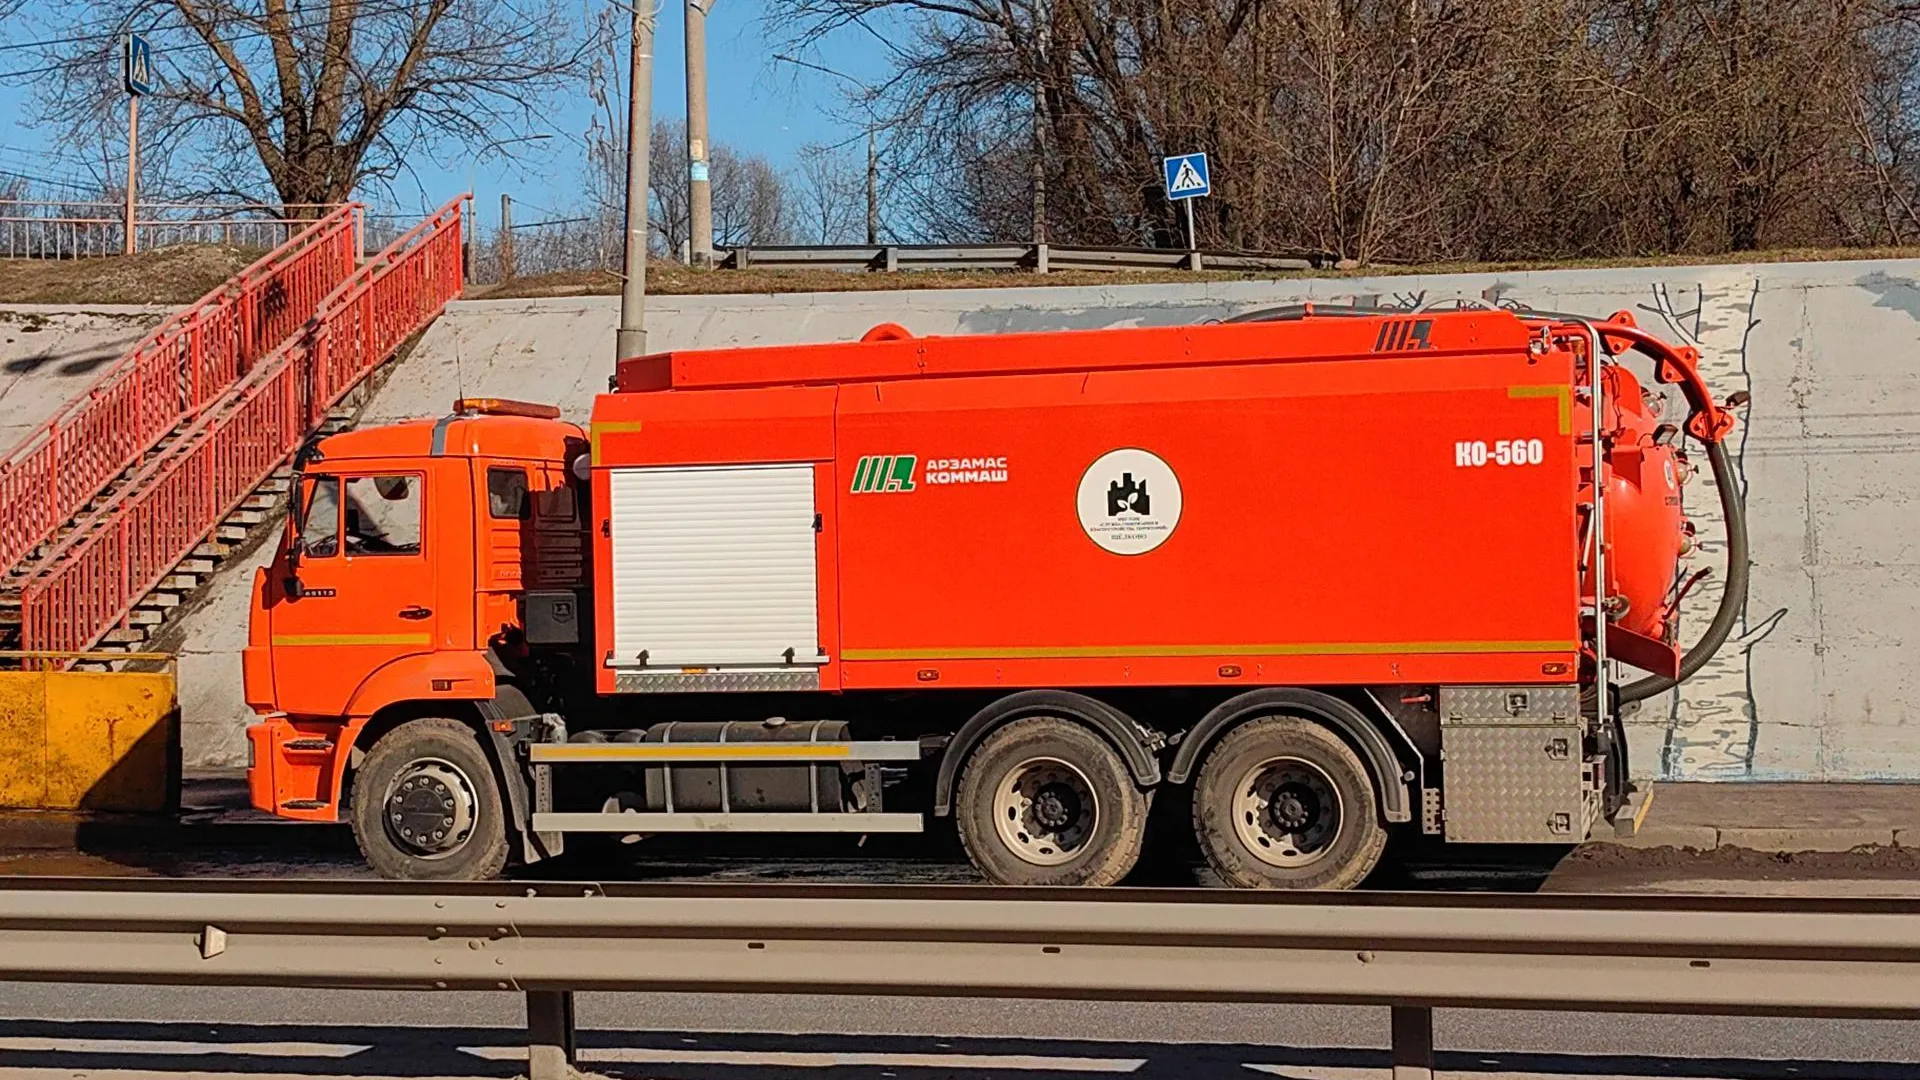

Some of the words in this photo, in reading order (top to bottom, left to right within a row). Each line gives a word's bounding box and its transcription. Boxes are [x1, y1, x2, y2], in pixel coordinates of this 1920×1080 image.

[1455, 438, 1543, 467] КО-560
[926, 457, 1008, 471] АРЗАМАС
[926, 470, 1008, 485] КОММАШ
